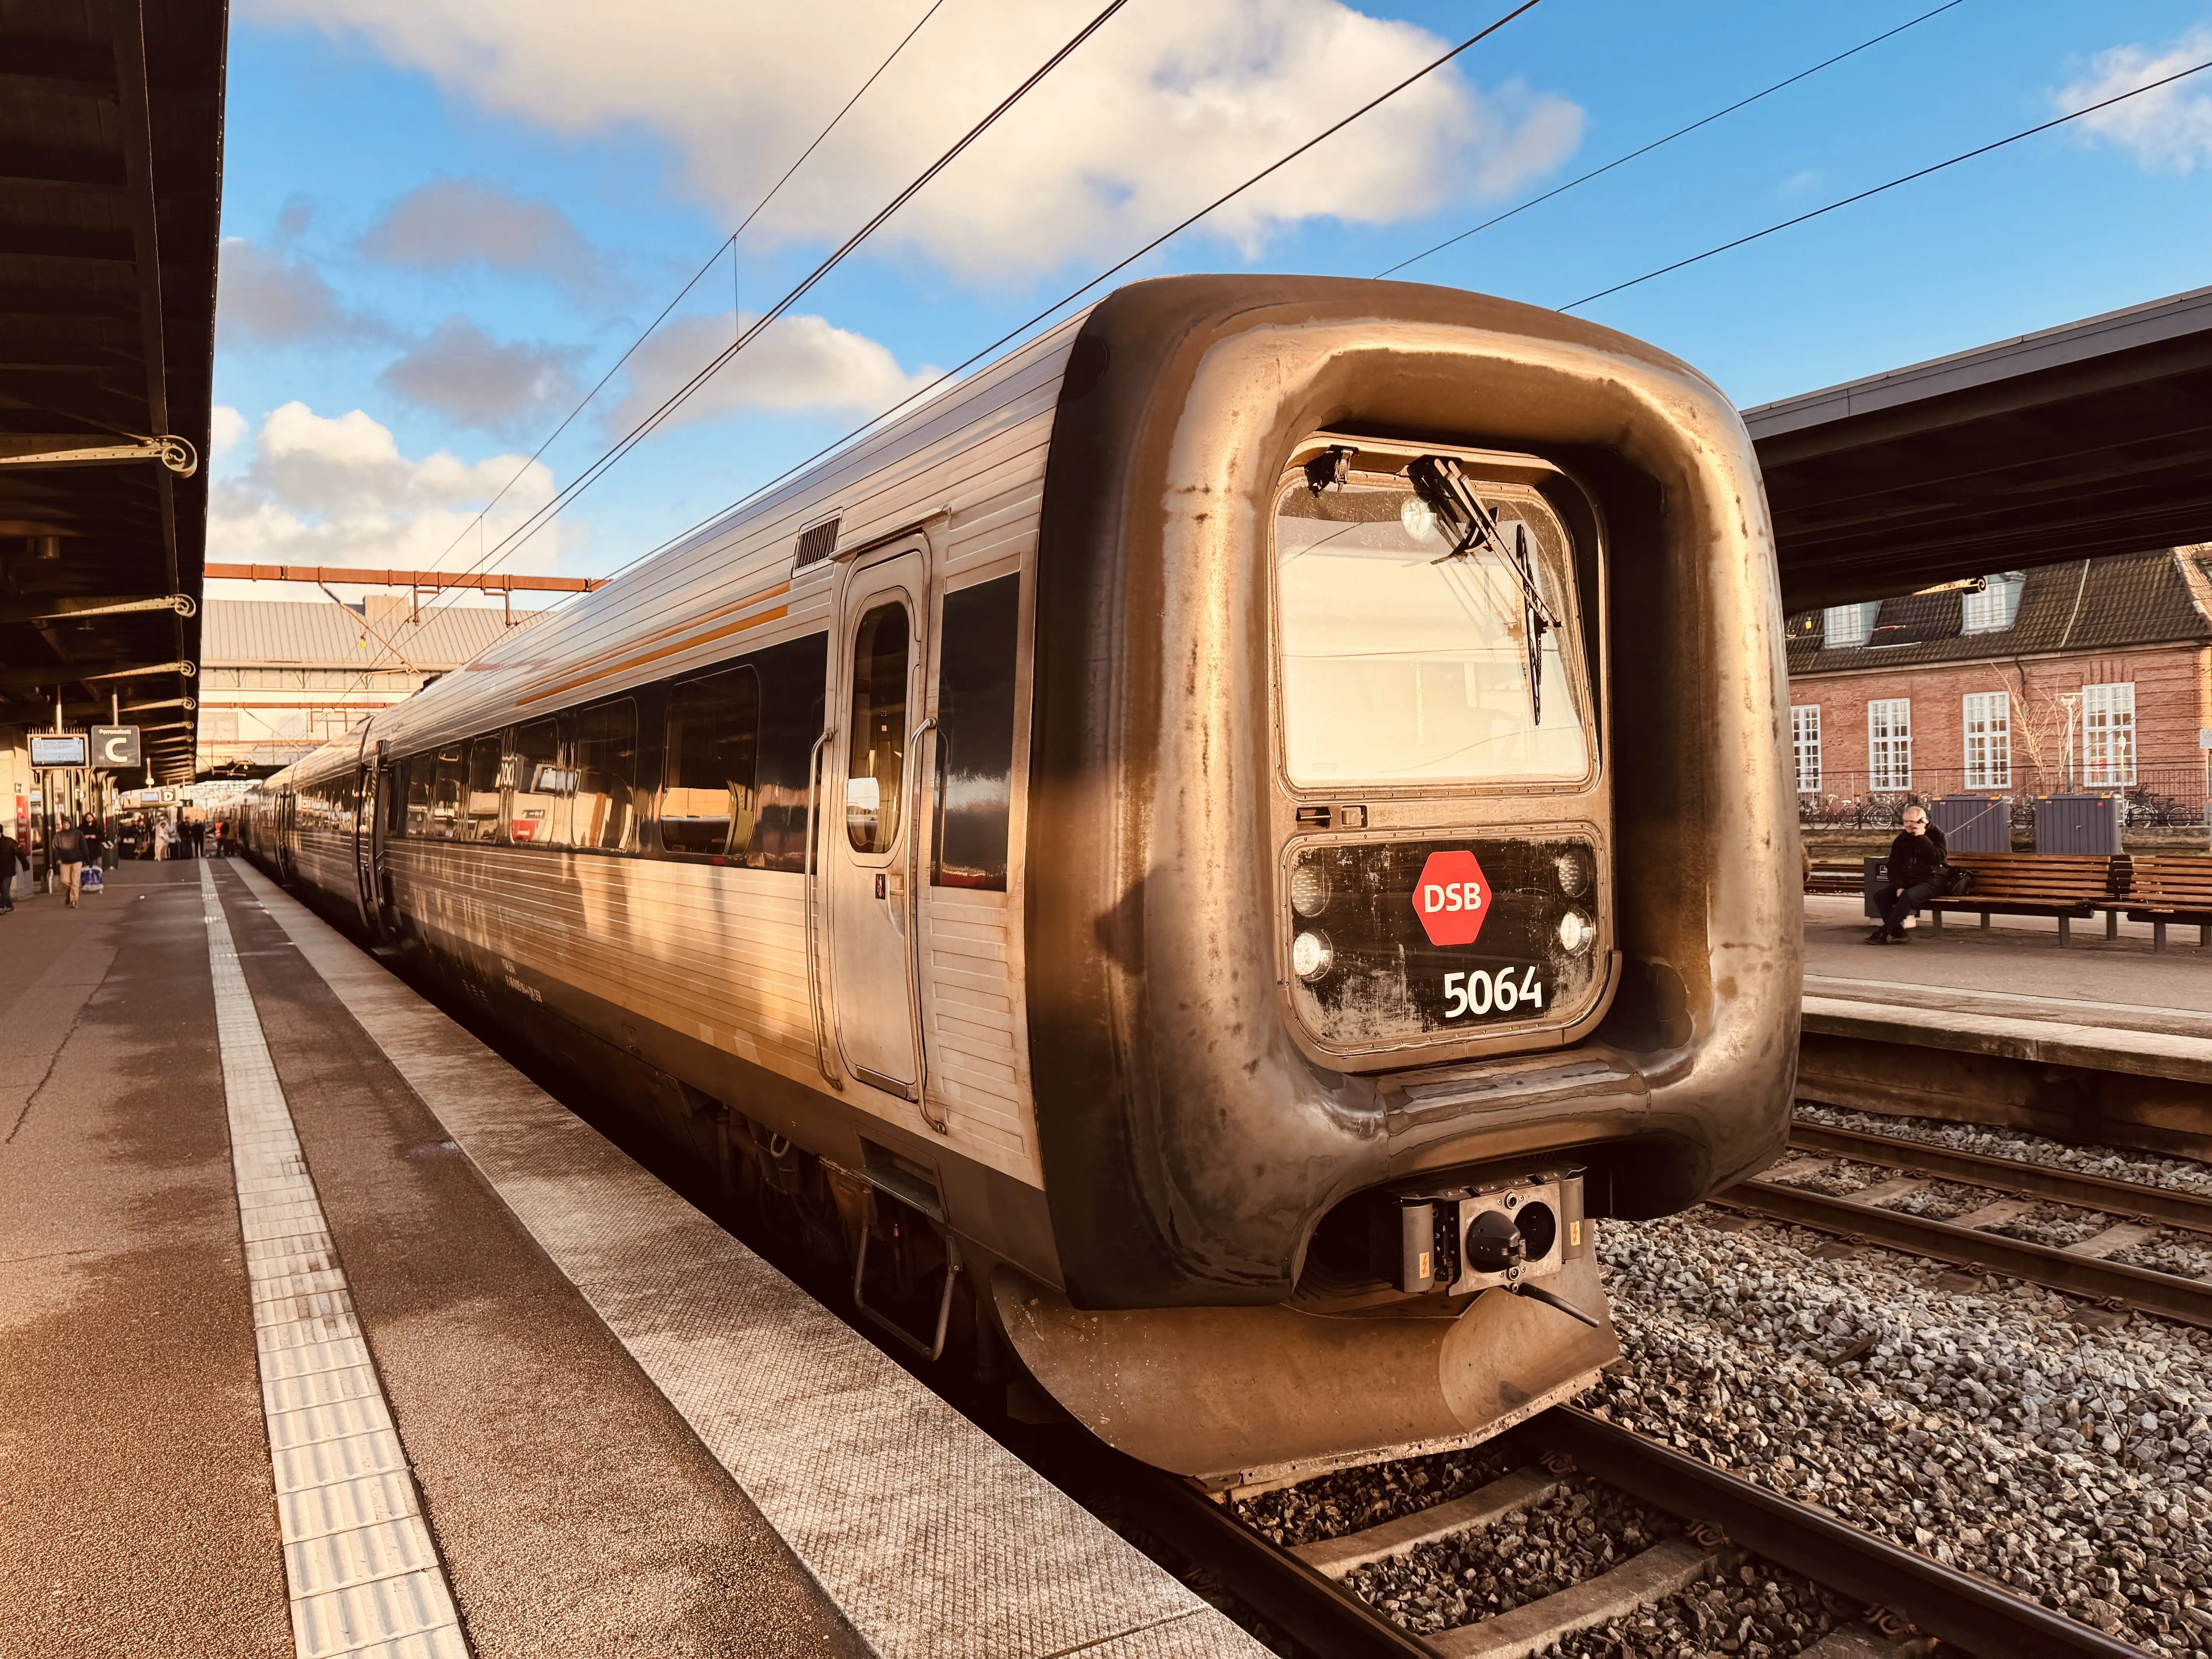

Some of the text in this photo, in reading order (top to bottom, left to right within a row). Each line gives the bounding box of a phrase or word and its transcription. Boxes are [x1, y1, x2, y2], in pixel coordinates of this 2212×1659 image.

[105, 737, 127, 763] C
[163, 792, 173, 801] D
[1424, 883, 1481, 913] DSB
[1444, 965, 1542, 1018] 5064
